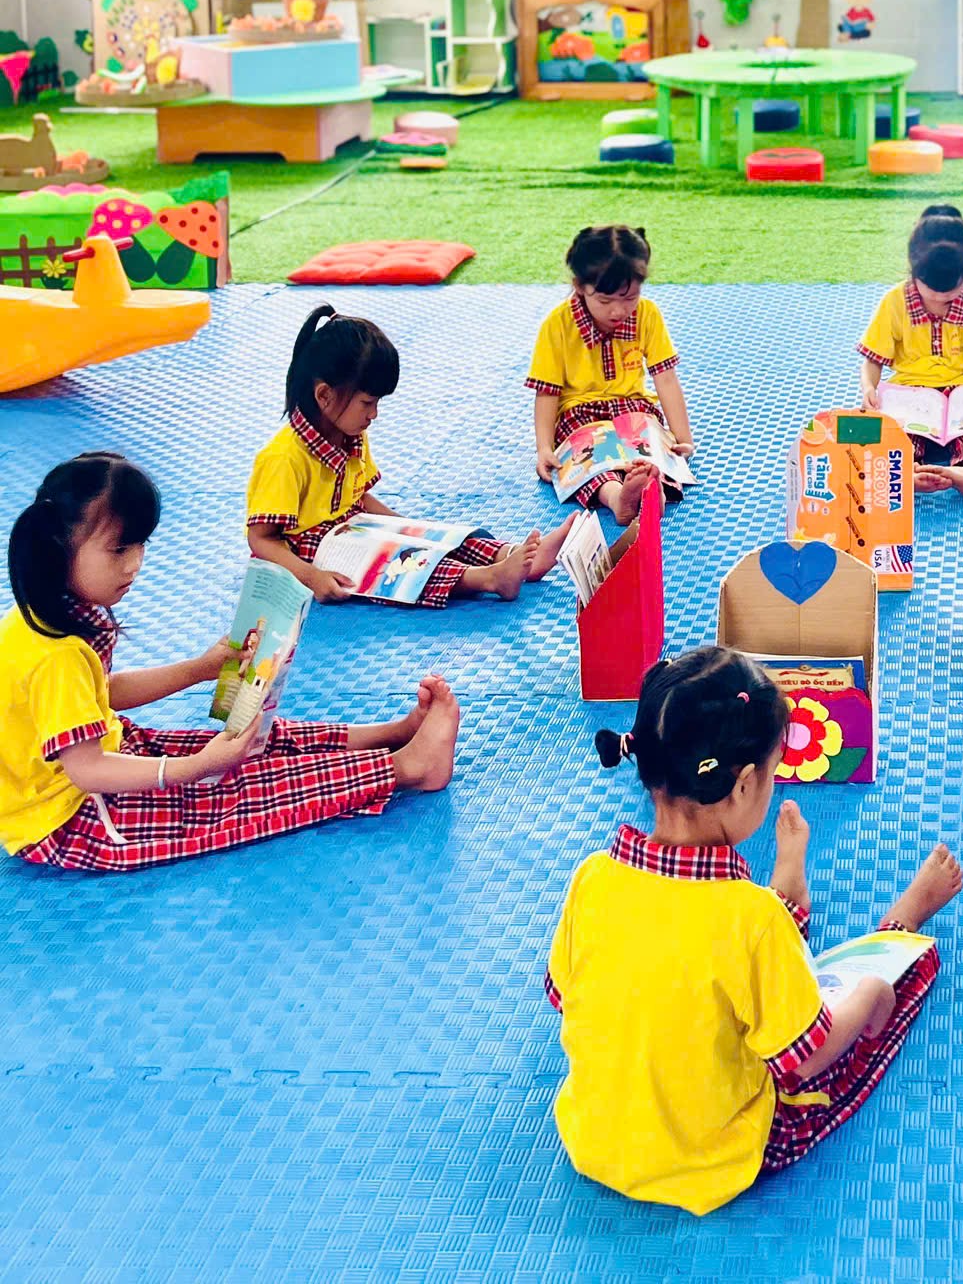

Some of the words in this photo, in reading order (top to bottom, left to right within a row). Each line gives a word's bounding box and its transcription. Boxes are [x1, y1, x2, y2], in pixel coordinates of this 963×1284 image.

[814, 455, 830, 490] Tăng
[874, 457, 888, 507] GROW
[889, 450, 902, 512] SMARTA
[874, 549, 882, 568] USA
